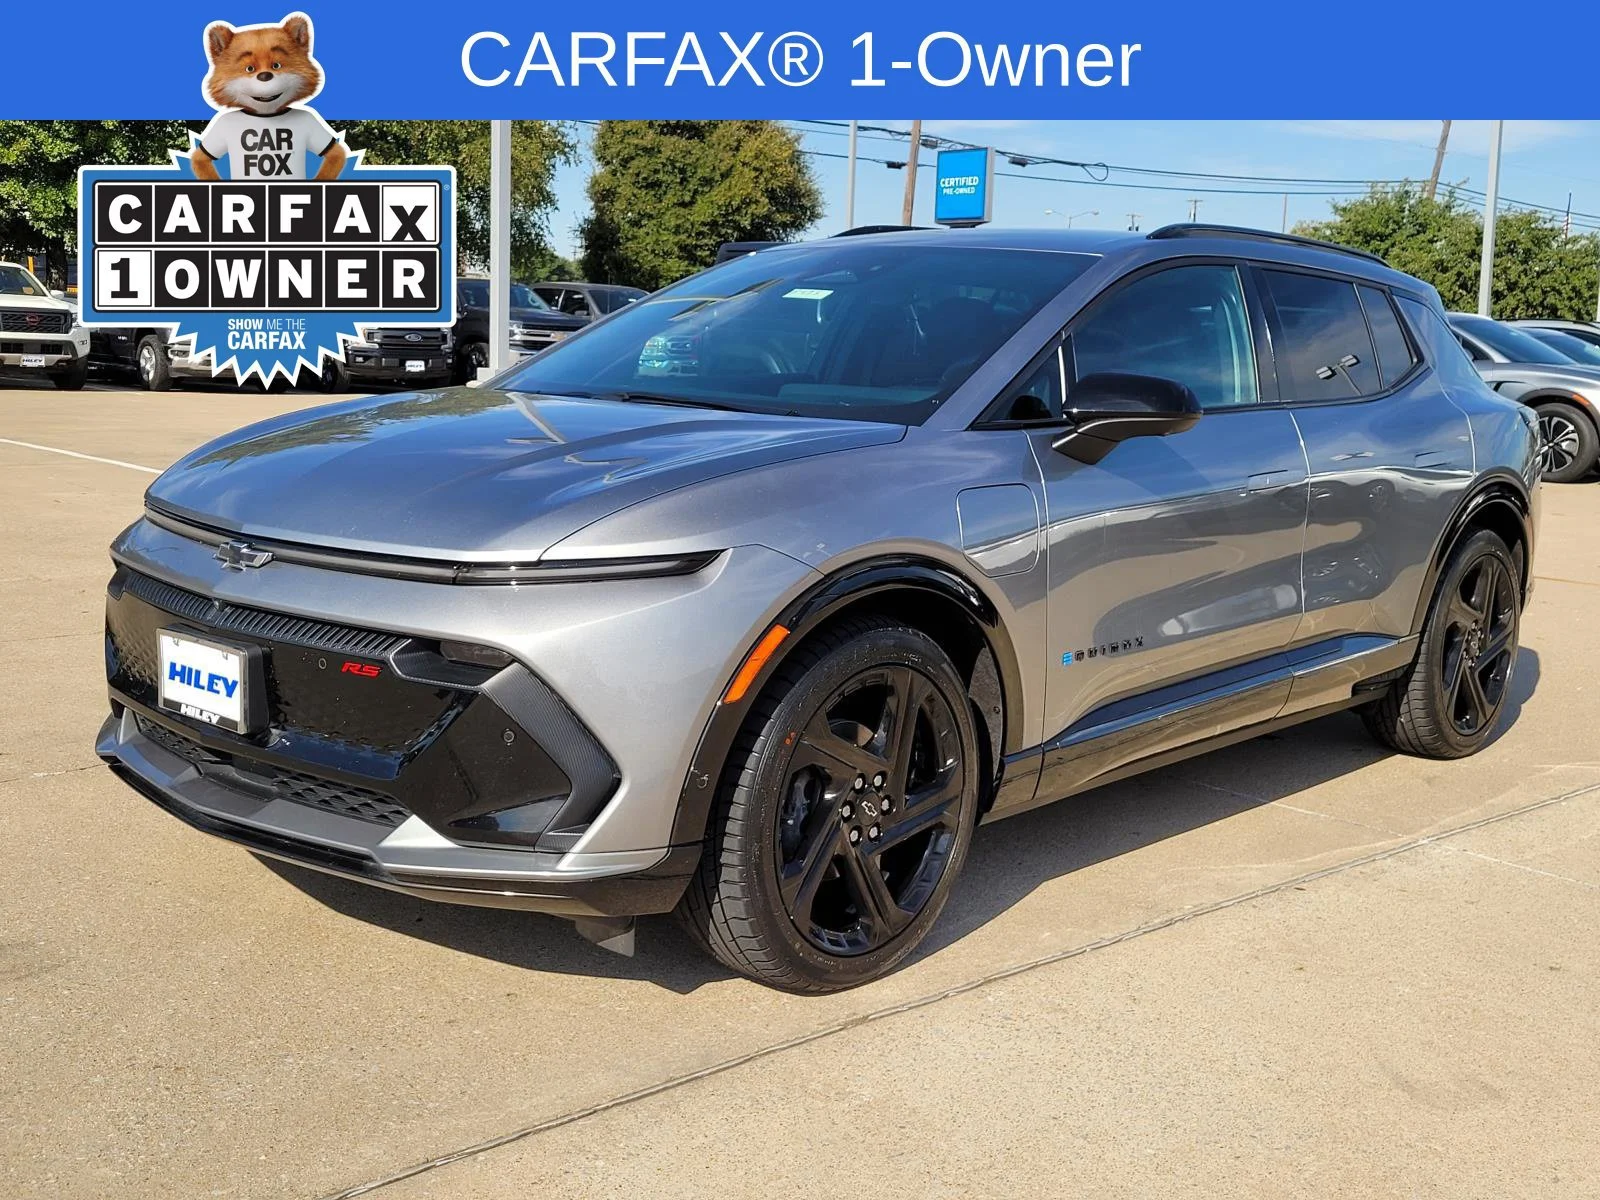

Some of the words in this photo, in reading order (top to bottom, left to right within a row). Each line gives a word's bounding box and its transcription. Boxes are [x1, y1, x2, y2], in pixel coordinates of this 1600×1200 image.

[940, 176, 979, 187] CERTIFIED
[943, 187, 975, 195] PRE-OWNED
[341, 662, 381, 677] RS
[168, 661, 239, 699] HILEY
[180, 703, 220, 724] HILEY
